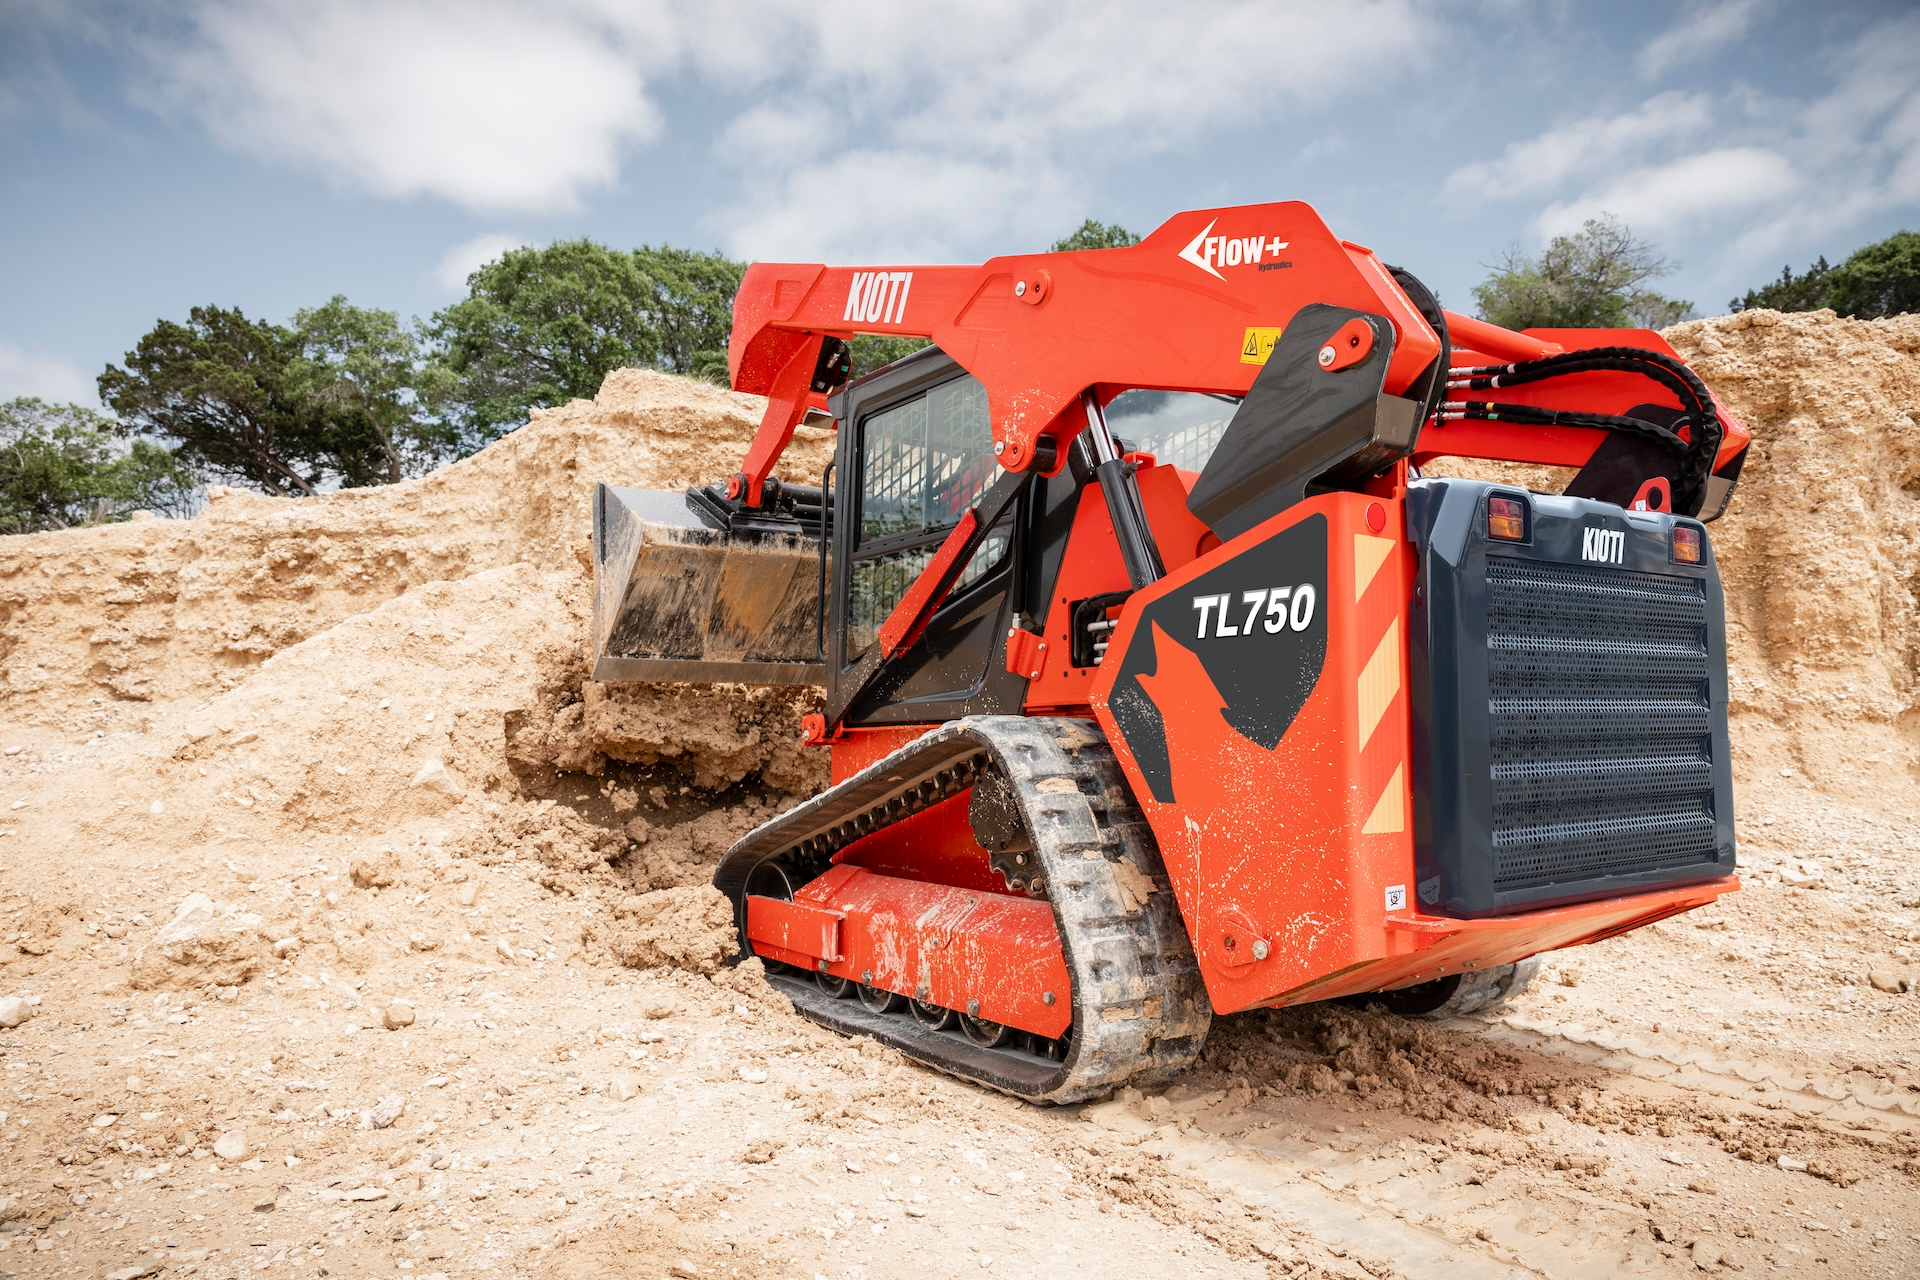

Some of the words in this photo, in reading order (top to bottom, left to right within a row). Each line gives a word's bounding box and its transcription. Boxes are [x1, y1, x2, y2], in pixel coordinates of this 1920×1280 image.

[1258, 261, 1293, 272] Hydraulics
[844, 271, 914, 324] KIOTI
[1582, 526, 1625, 564] KIOTI
[1192, 583, 1316, 640] TL750
